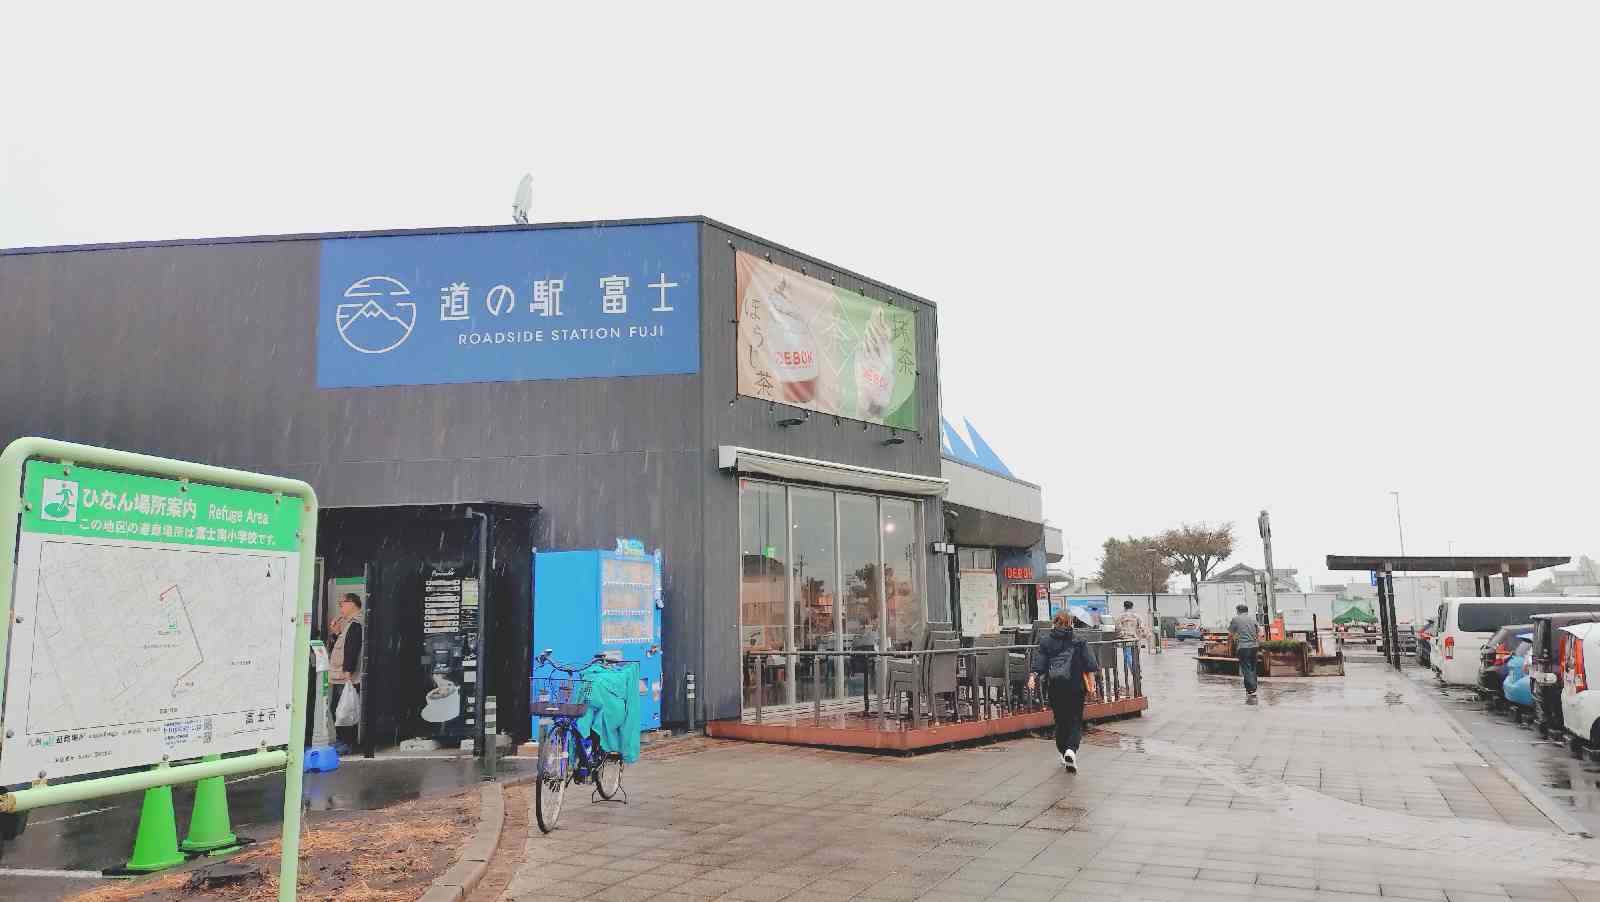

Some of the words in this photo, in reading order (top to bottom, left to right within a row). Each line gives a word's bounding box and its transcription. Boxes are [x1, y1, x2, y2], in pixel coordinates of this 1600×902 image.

[440, 279, 564, 321] 道の駅
[599, 272, 679, 315] 富士
[458, 330, 544, 345] ROADSIDE
[550, 326, 621, 342] STATION
[628, 325, 664, 338] FUJI
[81, 487, 198, 521] ひなん場所案内
[207, 502, 244, 524] Refuge
[246, 510, 270, 526] Area
